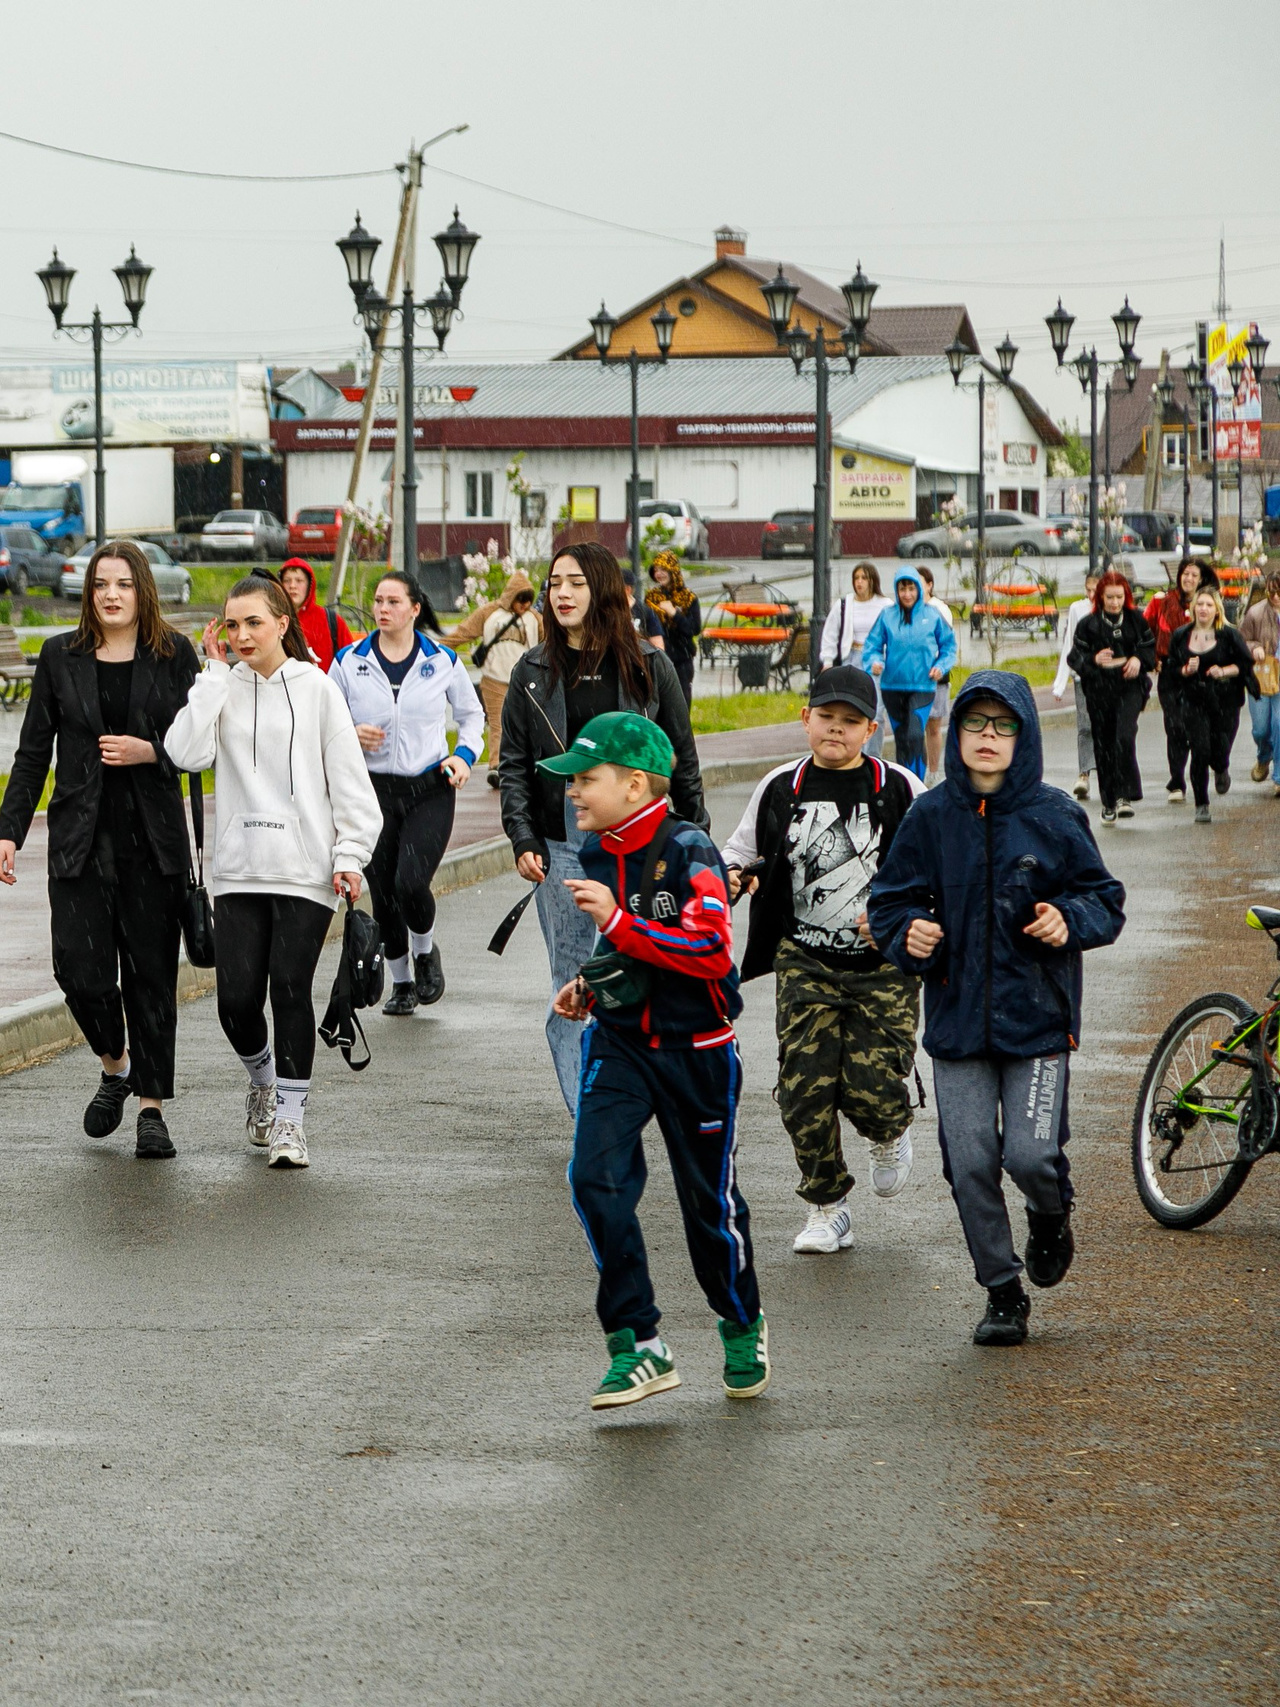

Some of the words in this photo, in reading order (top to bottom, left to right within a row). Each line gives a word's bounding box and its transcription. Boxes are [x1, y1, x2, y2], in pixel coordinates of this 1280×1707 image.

[59, 367, 229, 390] ШИНОМОНТАЖ
[786, 422, 817, 434] СЕРВИ
[840, 472, 904, 484] ЗАПРАВКА
[850, 486, 891, 498] АВТО
